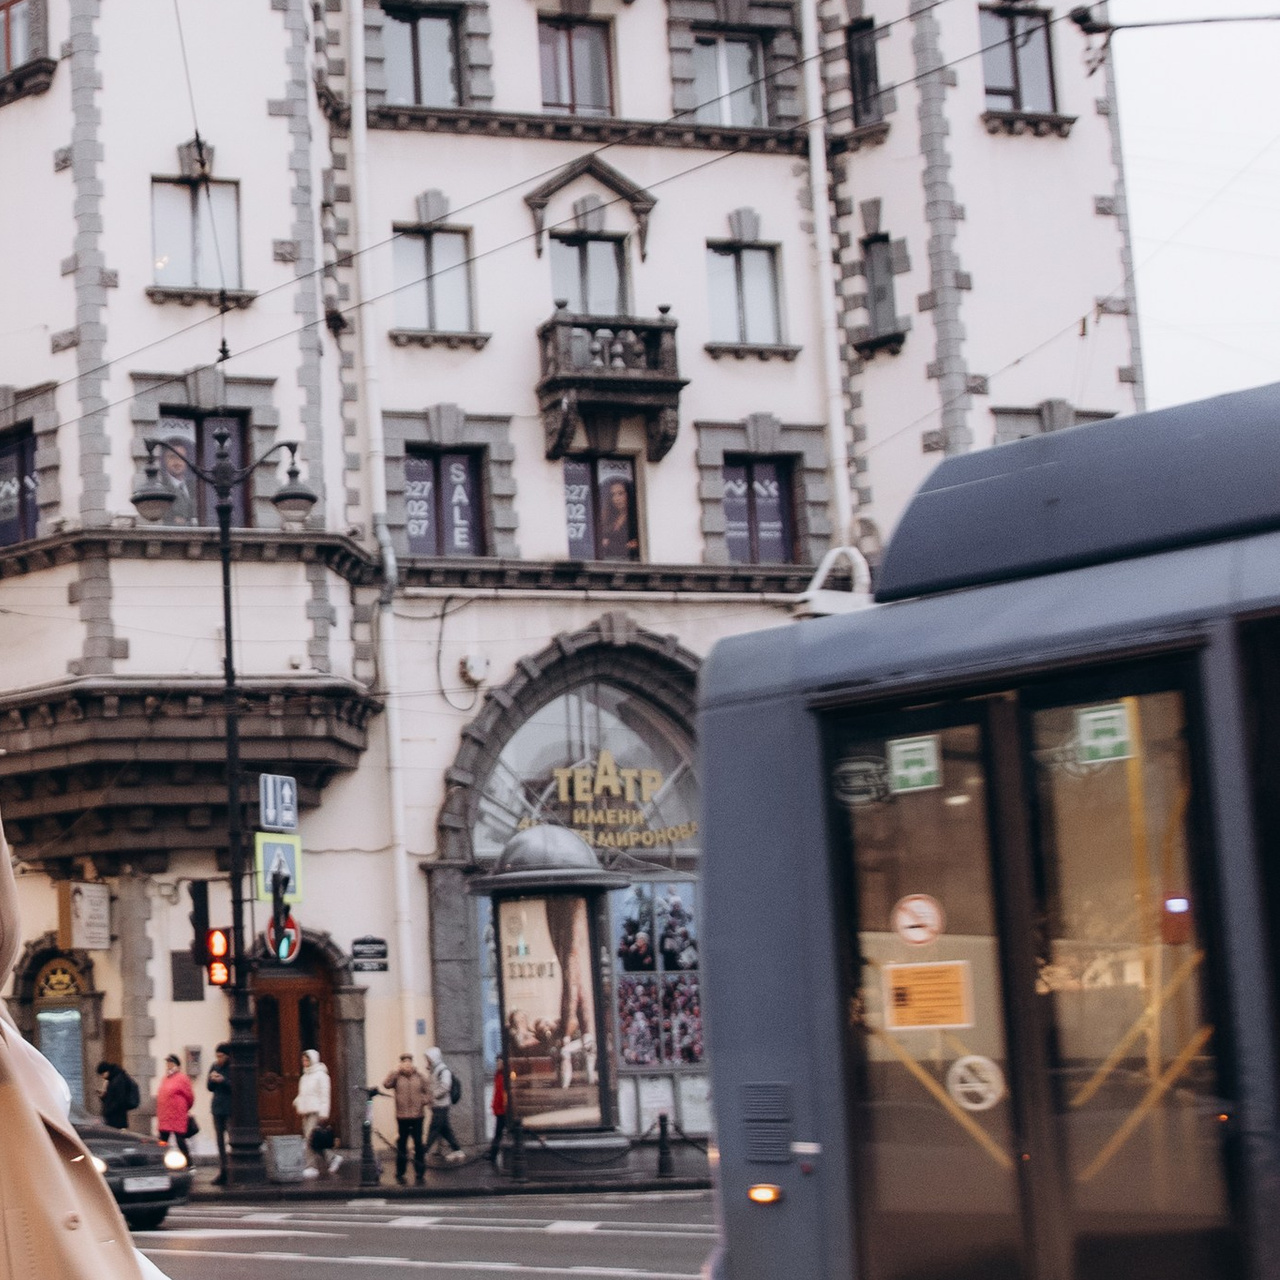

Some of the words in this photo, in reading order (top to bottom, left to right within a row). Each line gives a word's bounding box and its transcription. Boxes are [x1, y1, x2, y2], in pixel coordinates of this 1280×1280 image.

[407, 499, 429, 516] 02
[450, 462, 469, 548] SALE
[408, 519, 429, 536] 67
[553, 749, 663, 803] ТЕАТР
[572, 808, 645, 824] ИМЕНИ
